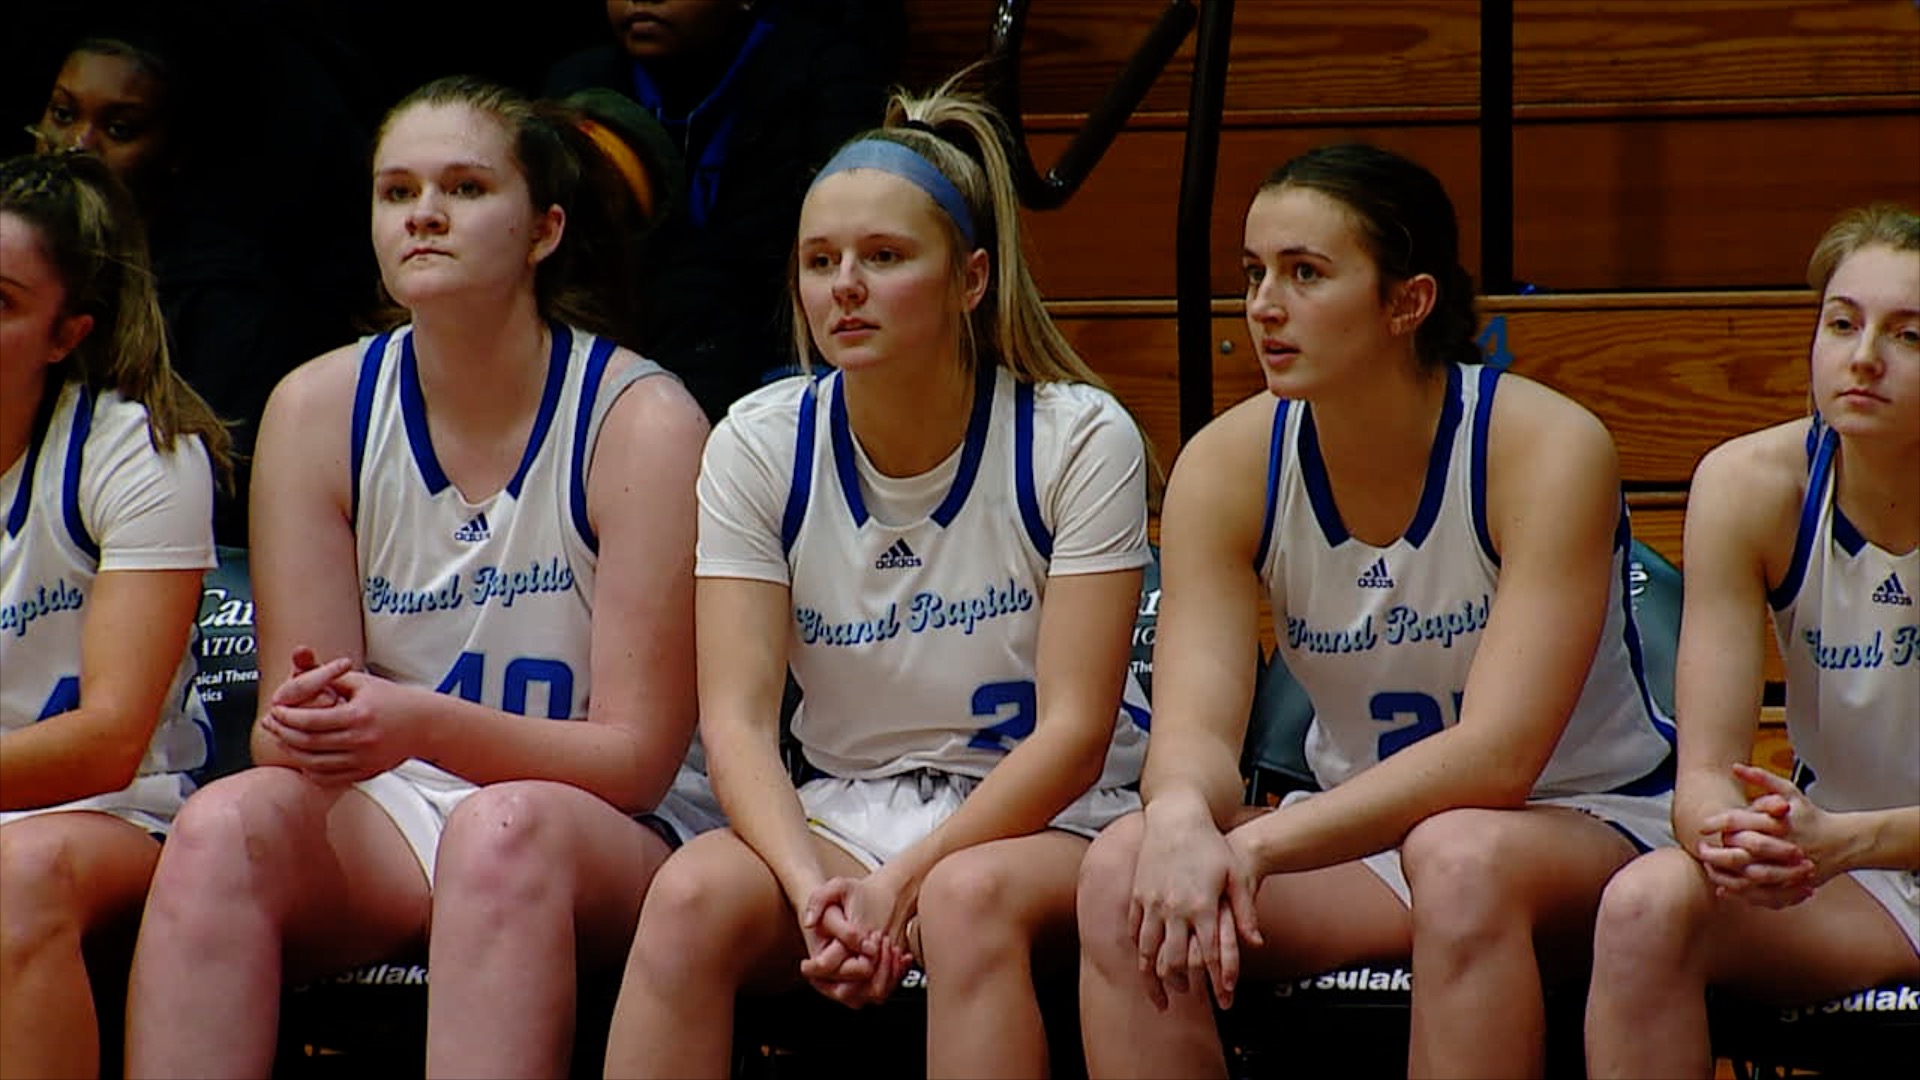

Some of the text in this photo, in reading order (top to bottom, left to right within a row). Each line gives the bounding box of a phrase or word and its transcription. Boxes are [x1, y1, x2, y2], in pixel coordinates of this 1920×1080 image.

[364, 556, 575, 614] Grand Rapids
[875, 555, 922, 570] adidas
[0, 577, 84, 637] apids
[796, 577, 1034, 646] Grand Rapids
[1384, 594, 1490, 648] Rapid
[1369, 691, 1465, 762] 2
